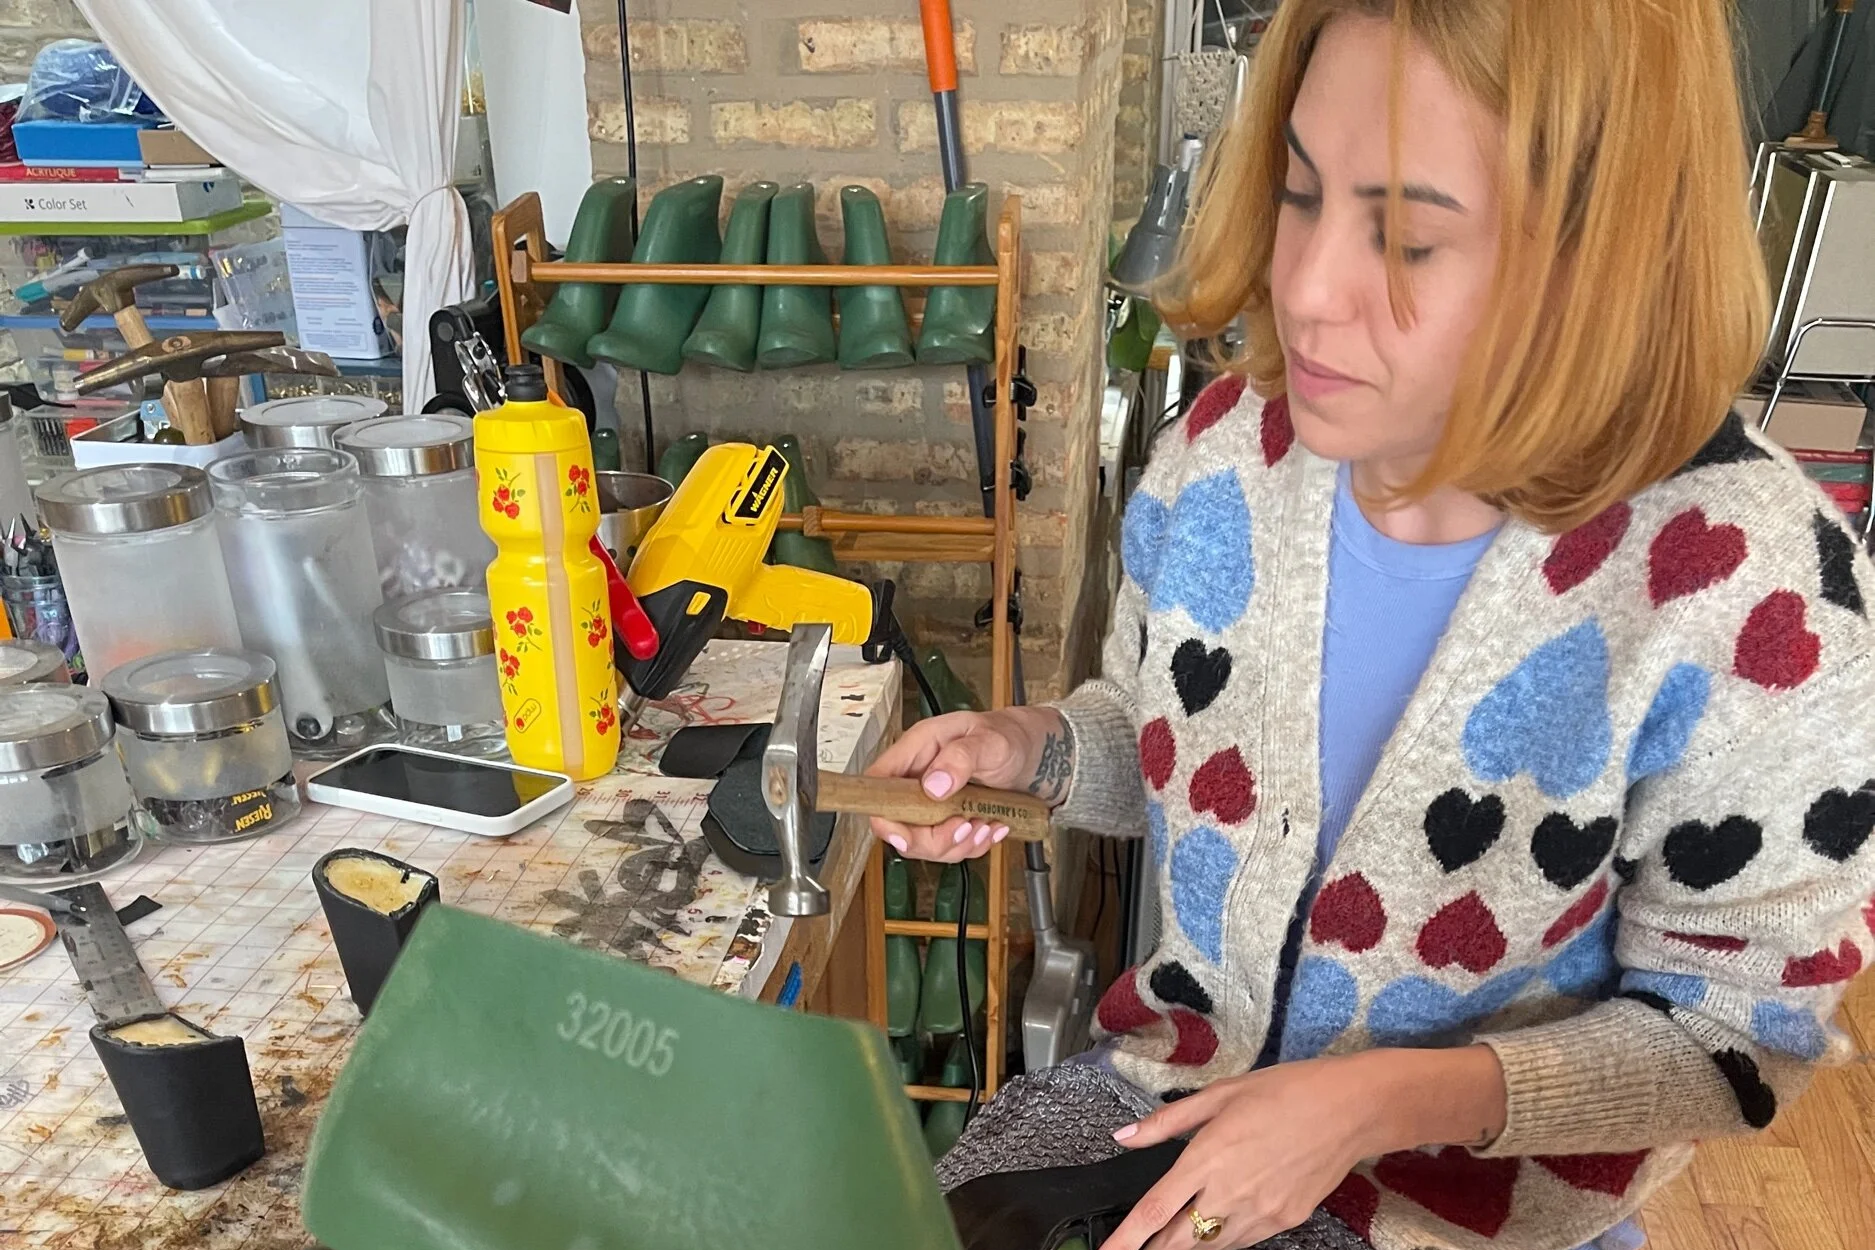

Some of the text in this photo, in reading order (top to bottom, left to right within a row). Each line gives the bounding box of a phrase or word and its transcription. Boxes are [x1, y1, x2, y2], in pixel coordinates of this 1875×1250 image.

[38, 198, 88, 210] Color Set
[750, 467, 779, 512] WAGNER
[235, 803, 273, 831] RIESEN
[556, 991, 680, 1077] 32005
